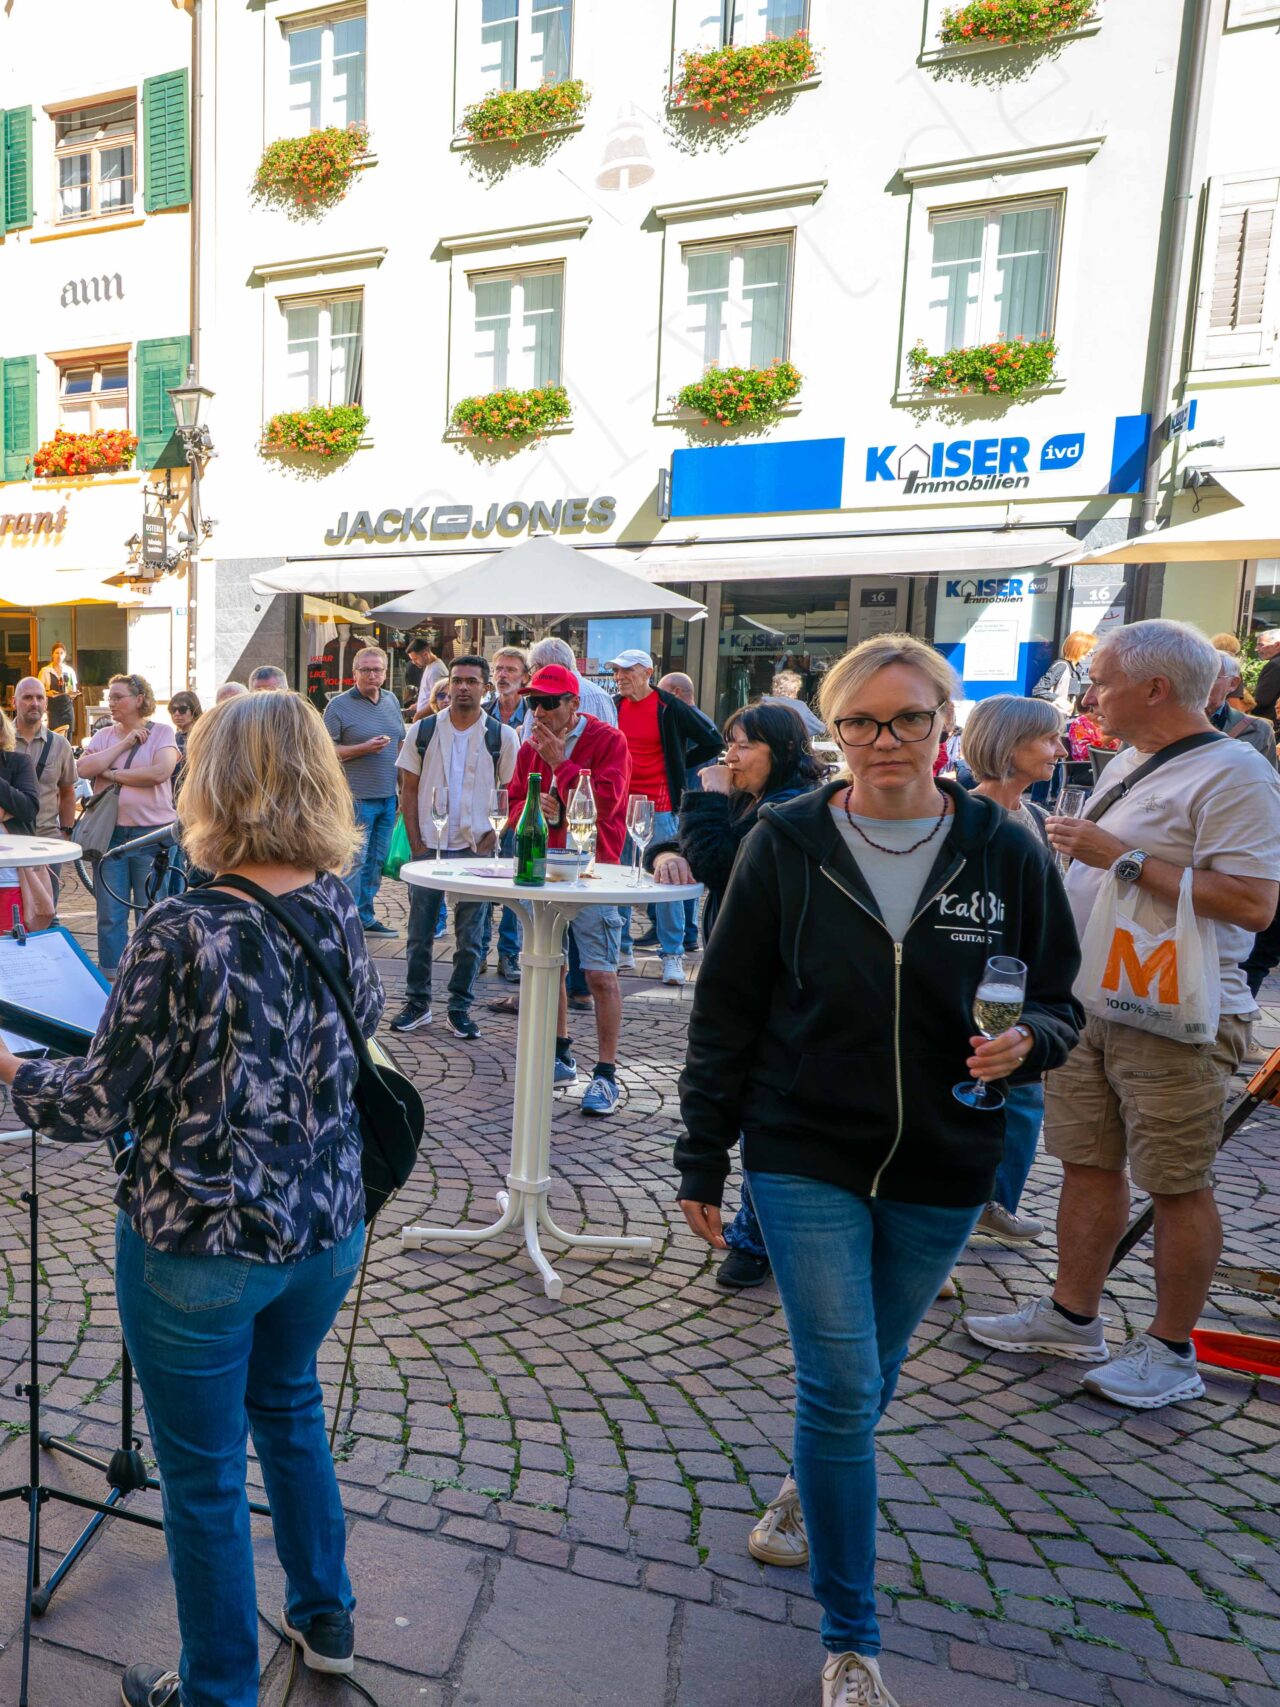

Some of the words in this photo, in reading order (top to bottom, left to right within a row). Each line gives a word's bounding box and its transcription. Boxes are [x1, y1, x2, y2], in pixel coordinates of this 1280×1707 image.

[1045, 443, 1080, 460] ivd
[902, 470, 1030, 494] Immobilien
[324, 507, 429, 546] JACK
[472, 496, 616, 539] JONES
[872, 591, 886, 602] 16
[963, 592, 1023, 604] Immobilien
[1089, 587, 1110, 601] 16
[1105, 997, 1145, 1015] 100%
[1213, 1270, 1230, 1280] IHL
